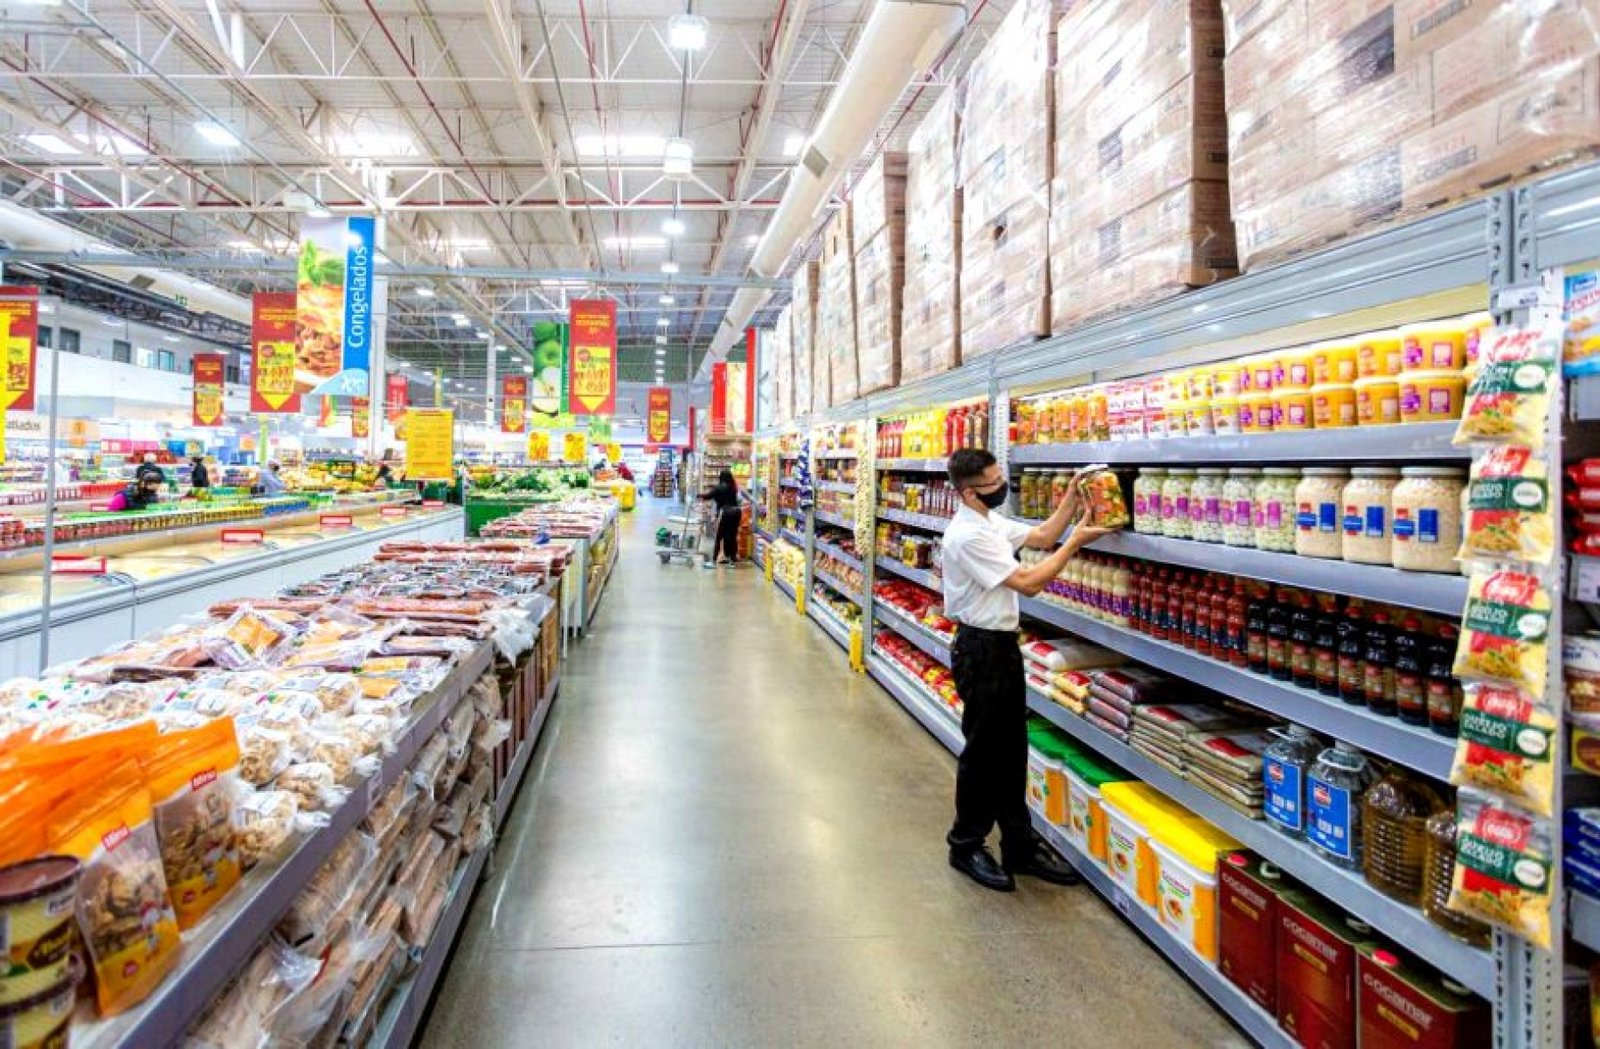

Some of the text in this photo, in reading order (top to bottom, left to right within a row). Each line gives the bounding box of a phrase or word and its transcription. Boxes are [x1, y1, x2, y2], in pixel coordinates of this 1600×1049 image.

[347, 246, 369, 348] Congelados
[1283, 916, 1337, 964] cocamar
[1363, 973, 1433, 1030] cocamar
